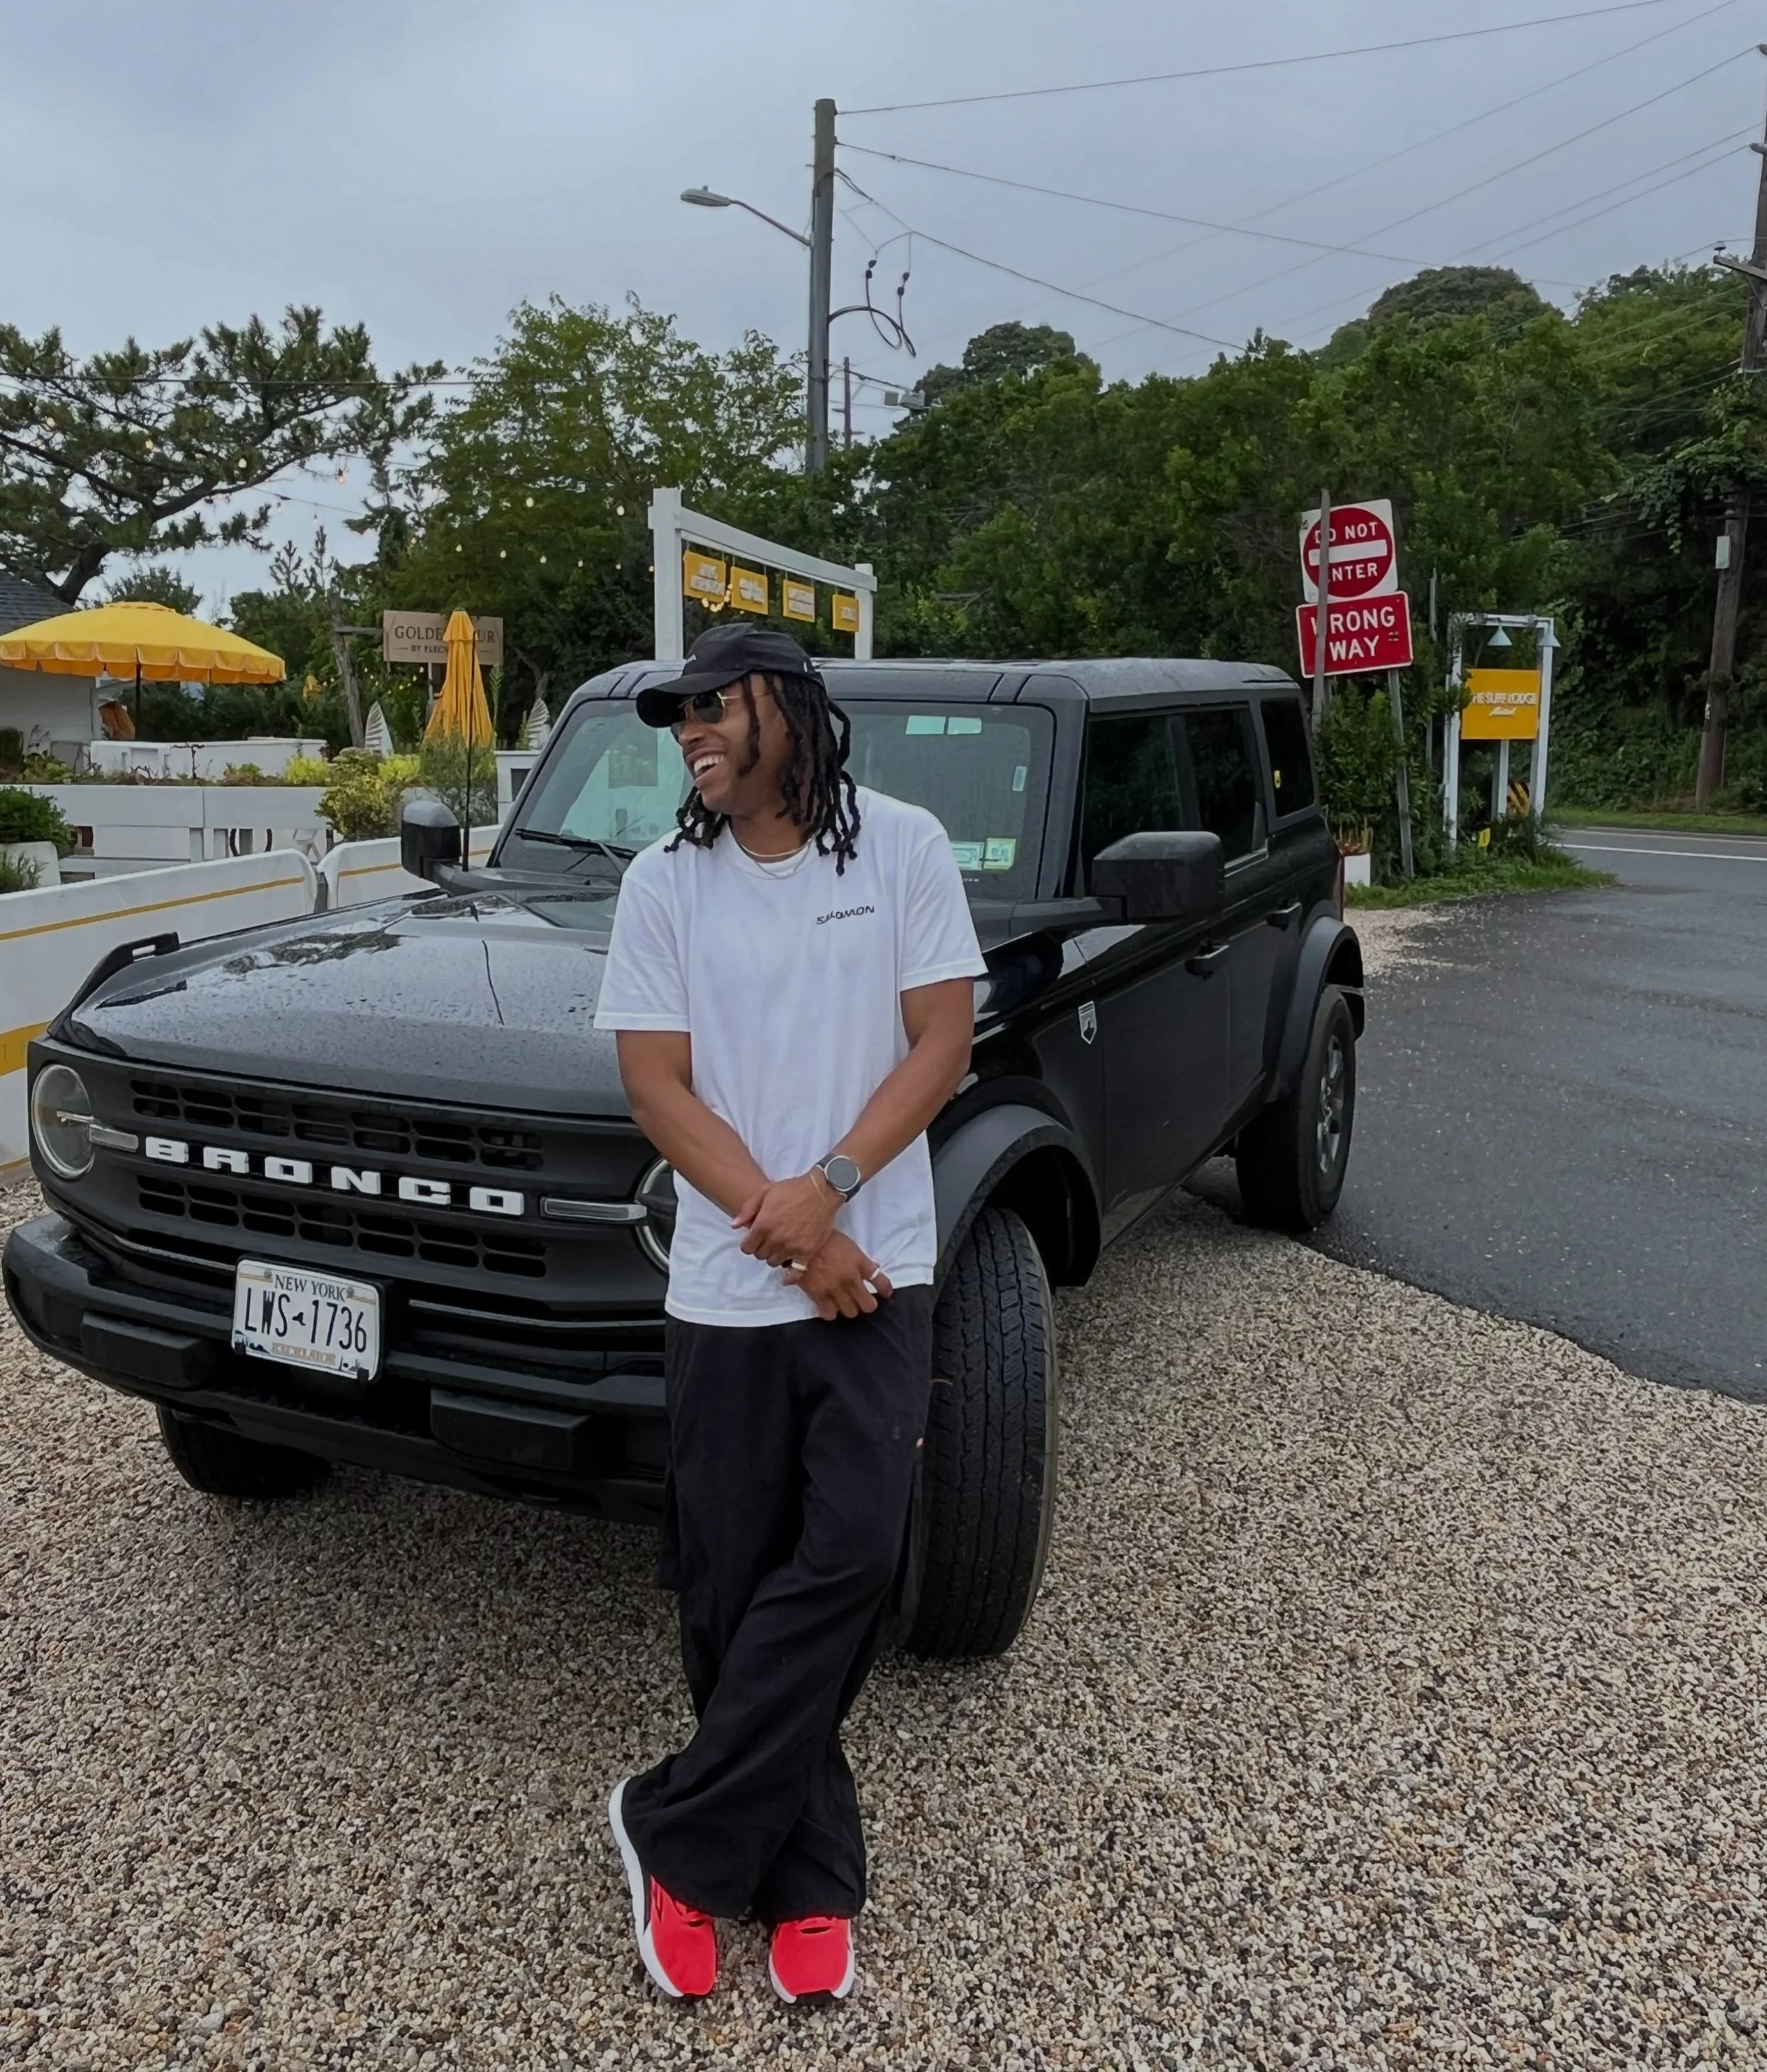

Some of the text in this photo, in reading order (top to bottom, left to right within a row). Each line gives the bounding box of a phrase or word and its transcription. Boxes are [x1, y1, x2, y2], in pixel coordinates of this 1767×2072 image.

[1315, 522, 1378, 544] DO NOT
[1328, 563, 1378, 582] NTER
[394, 625, 444, 641] GOLDE
[1329, 635, 1379, 661] WAY
[816, 905, 874, 924] SALOMON
[146, 1136, 524, 1215] BRONCO
[274, 1274, 345, 1302] NEW YORK
